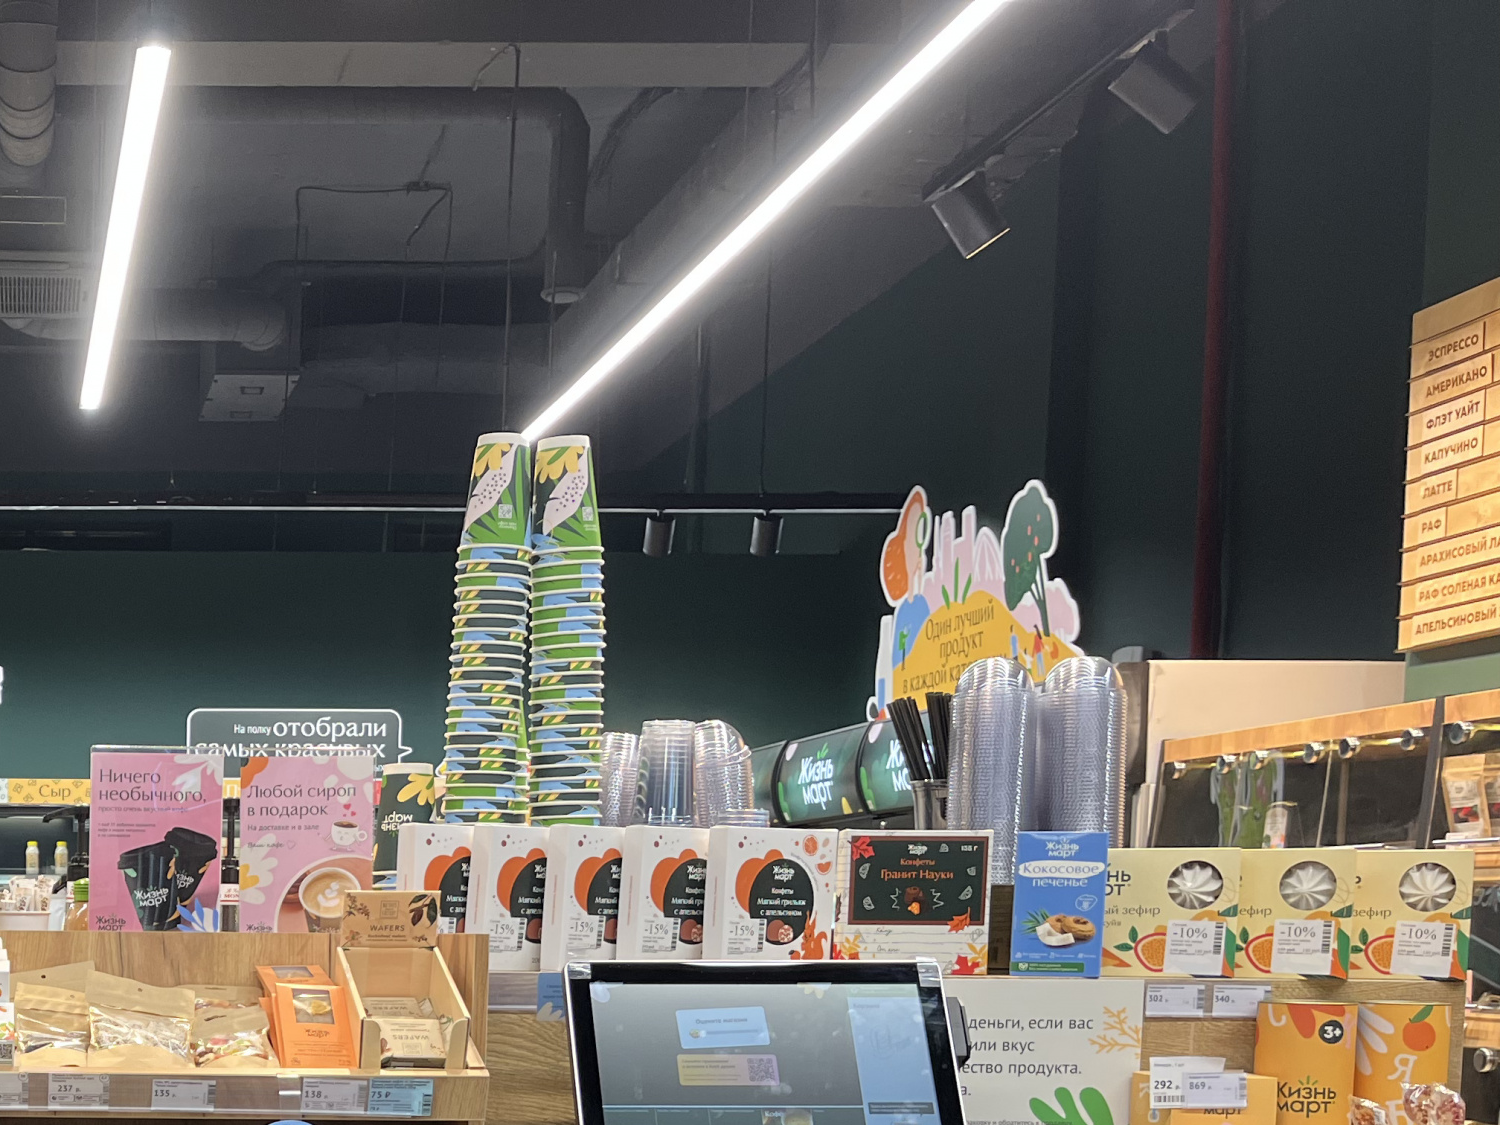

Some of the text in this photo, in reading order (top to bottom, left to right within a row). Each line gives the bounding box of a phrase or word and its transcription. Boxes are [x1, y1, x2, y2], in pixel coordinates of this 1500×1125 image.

[1428, 334, 1479, 362] ЭСПРЕССО
[1426, 366, 1488, 398] АМЕРИКАНО
[1426, 400, 1481, 430] ФЛЭТ УАЙТ
[1424, 436, 1478, 465] КАПУЧИНО
[1422, 480, 1453, 500] ЛАТТЕ
[1421, 518, 1442, 534] РАФ
[1420, 537, 1487, 567] АРАХИСОВЫЙ
[1419, 589, 1439, 602] РАФ
[925, 599, 995, 642] Один лучший
[1415, 604, 1497, 635] АПЕЛЬСИНОВЫЙ
[939, 631, 984, 665] продукт
[902, 679, 908, 694] в
[910, 664, 948, 692] каждой
[233, 717, 387, 742] На полку отобрали
[100, 769, 161, 784] Ничего
[798, 756, 834, 784] Жизнь
[39, 784, 72, 800] Сыр
[99, 786, 207, 804] необычного,
[247, 784, 357, 800] Любой сироп
[801, 781, 834, 810] март
[248, 804, 328, 819] в подарок
[900, 858, 936, 866] Конфеты
[1023, 862, 1100, 874] Кокосовое
[881, 869, 954, 880] Гранит Науки
[1032, 878, 1088, 888] печенье
[134, 887, 169, 900] Жизнь
[139, 896, 169, 908] март
[1122, 906, 1161, 916] зефир
[1352, 907, 1392, 920] зефир
[96, 916, 126, 926] Жизнь
[570, 922, 594, 933] -15%
[370, 924, 406, 932] WAFERS
[490, 924, 514, 935] -15%
[644, 924, 668, 935] -15%
[730, 925, 754, 936] -15%
[1172, 928, 1208, 939] -10%
[1280, 926, 1316, 938] -10%
[1401, 928, 1437, 940] -10%
[968, 1017, 1094, 1030] деньги, если вас
[1323, 1026, 1343, 1039] 3+
[970, 1041, 1035, 1054] или вкус
[1008, 1062, 1082, 1077] продукта.
[58, 1084, 73, 1092] 237
[1154, 1080, 1172, 1090] 292
[1188, 1082, 1206, 1090] 869
[154, 1090, 170, 1098] 135
[304, 1090, 322, 1098] 138
